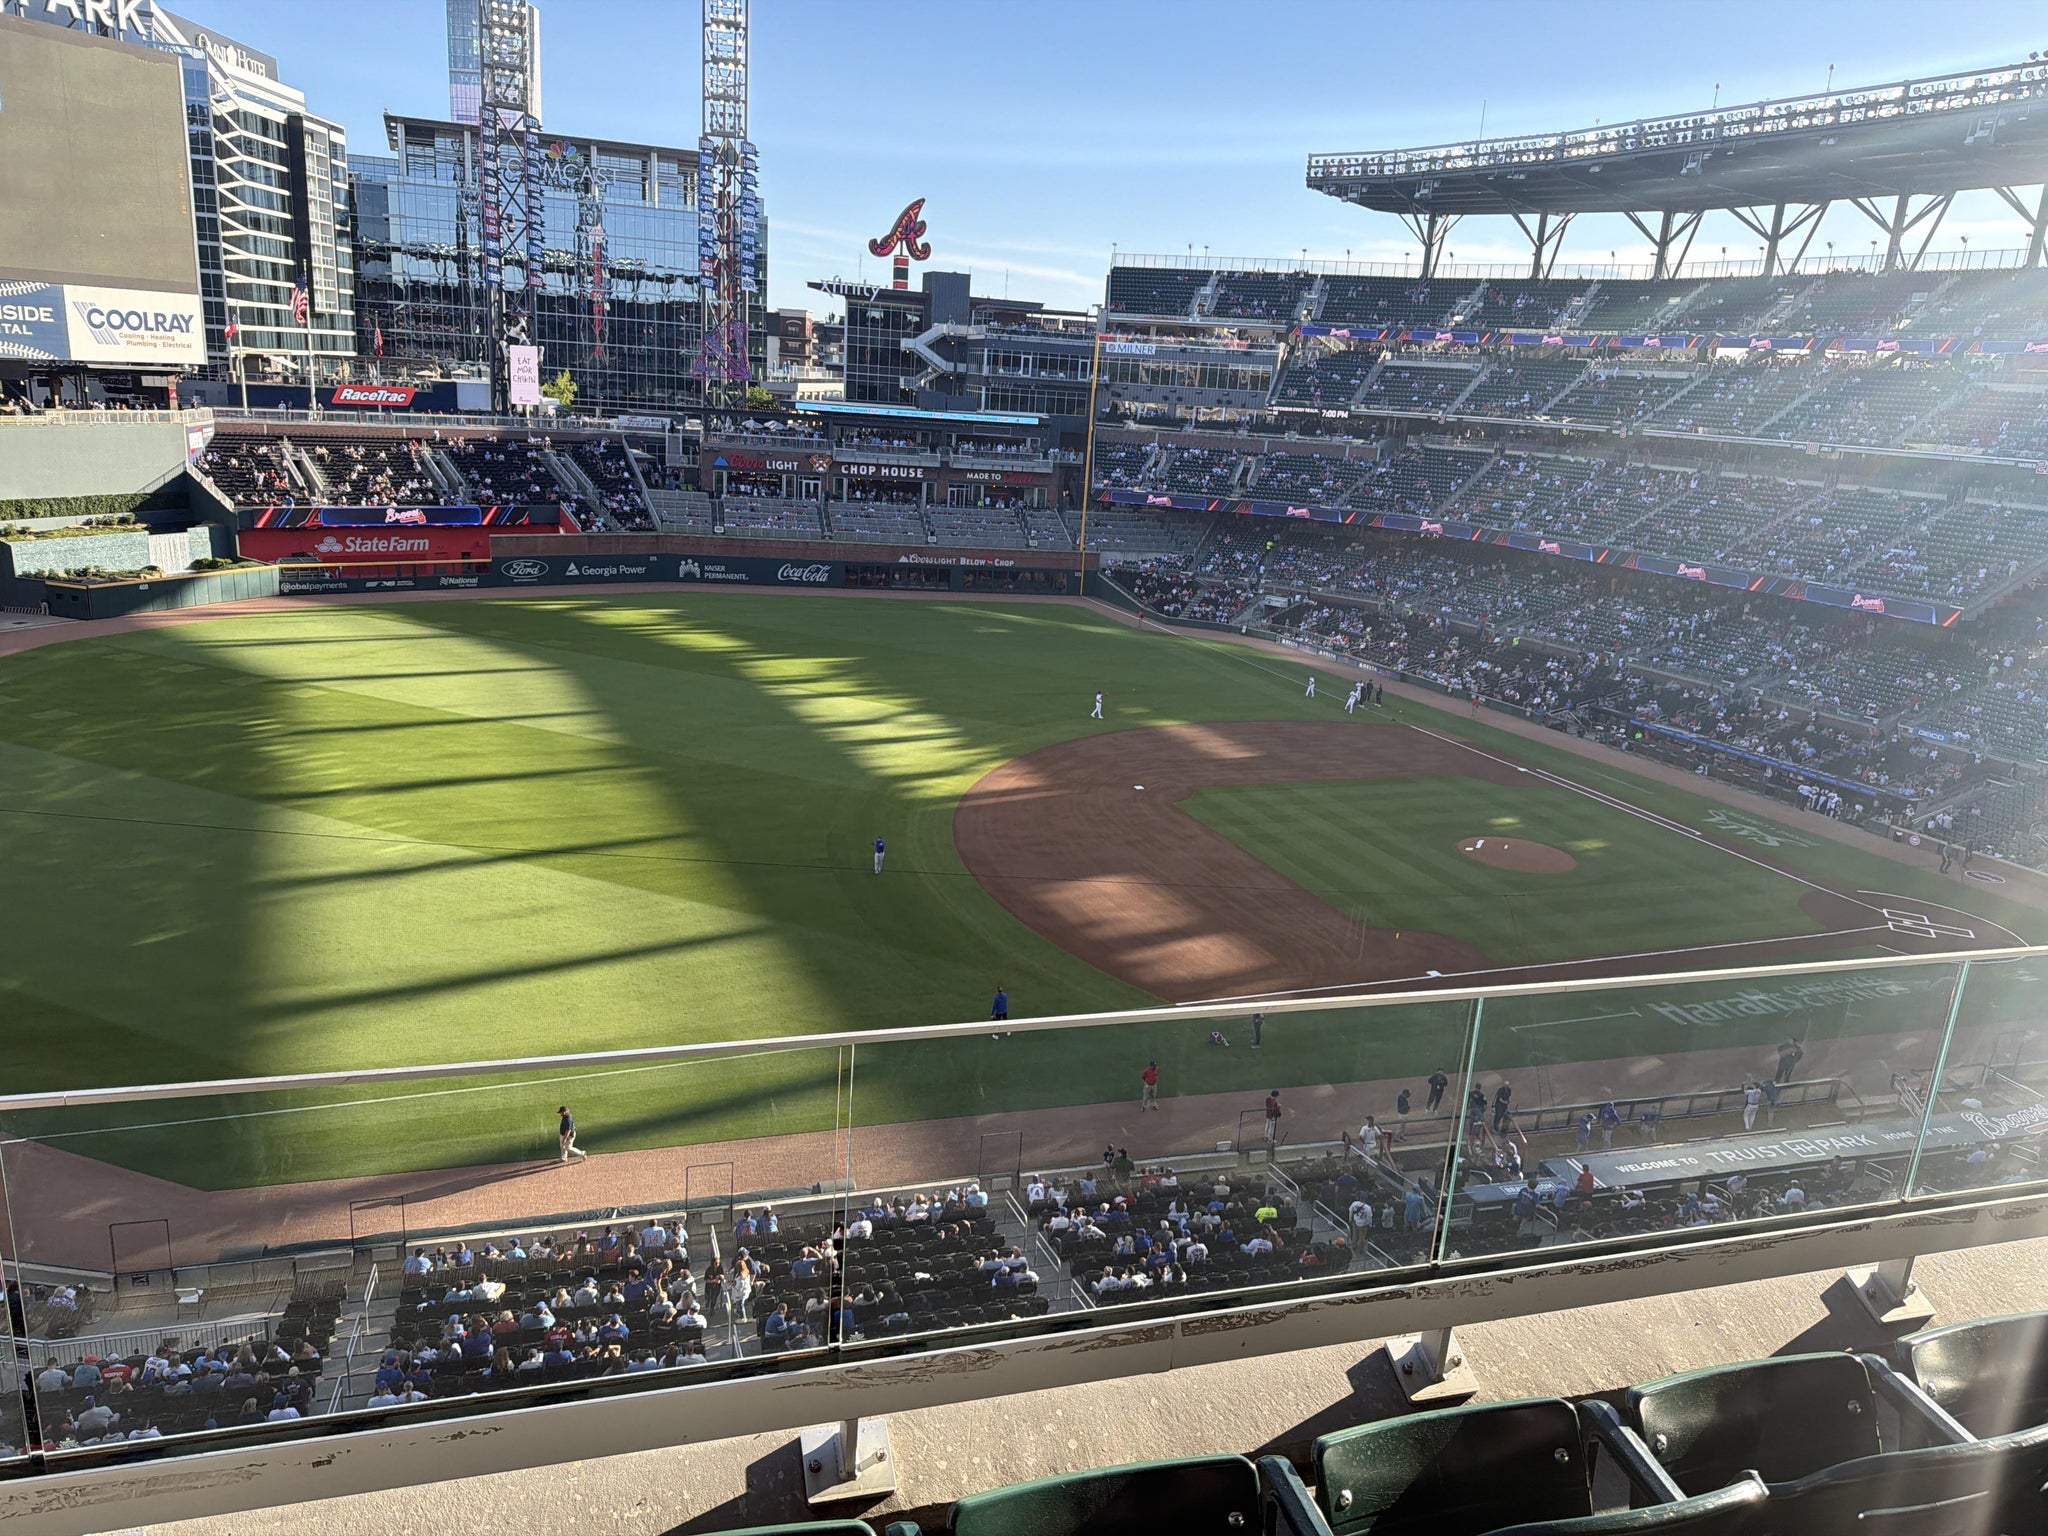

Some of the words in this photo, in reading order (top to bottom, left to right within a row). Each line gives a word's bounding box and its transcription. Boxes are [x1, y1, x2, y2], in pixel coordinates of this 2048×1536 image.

[820, 275, 880, 302] xfinity
[86, 308, 194, 334] COOLRAY
[119, 332, 145, 341] Cooling
[126, 341, 157, 349] Plumbing
[1117, 344, 1154, 355] MILNER
[518, 357, 531, 365] EAT
[517, 366, 533, 374] MOR
[340, 388, 407, 402] RaceTrac
[1321, 409, 1336, 418] 7:00
[1337, 410, 1349, 419] PM
[729, 454, 765, 469] Coors
[766, 460, 799, 470] LIGHT
[841, 465, 876, 475] CHOP
[881, 467, 924, 478] HOUSE
[966, 472, 990, 480] MADE
[510, 562, 540, 575] Ford
[581, 565, 618, 577] Georgia
[619, 564, 647, 575] Power
[778, 563, 832, 582] Coca-Cola
[448, 576, 479, 585] National
[704, 572, 746, 580] PERMANENTE
[281, 582, 347, 593] globalpayments
[1881, 1130, 1916, 1140] HOME
[1932, 1126, 1958, 1135] THE
[1705, 1144, 1788, 1164] TRUIST
[1816, 1134, 1878, 1151] PARK
[1615, 1158, 1678, 1174] WELCOME
[1680, 1157, 1699, 1166] TO
